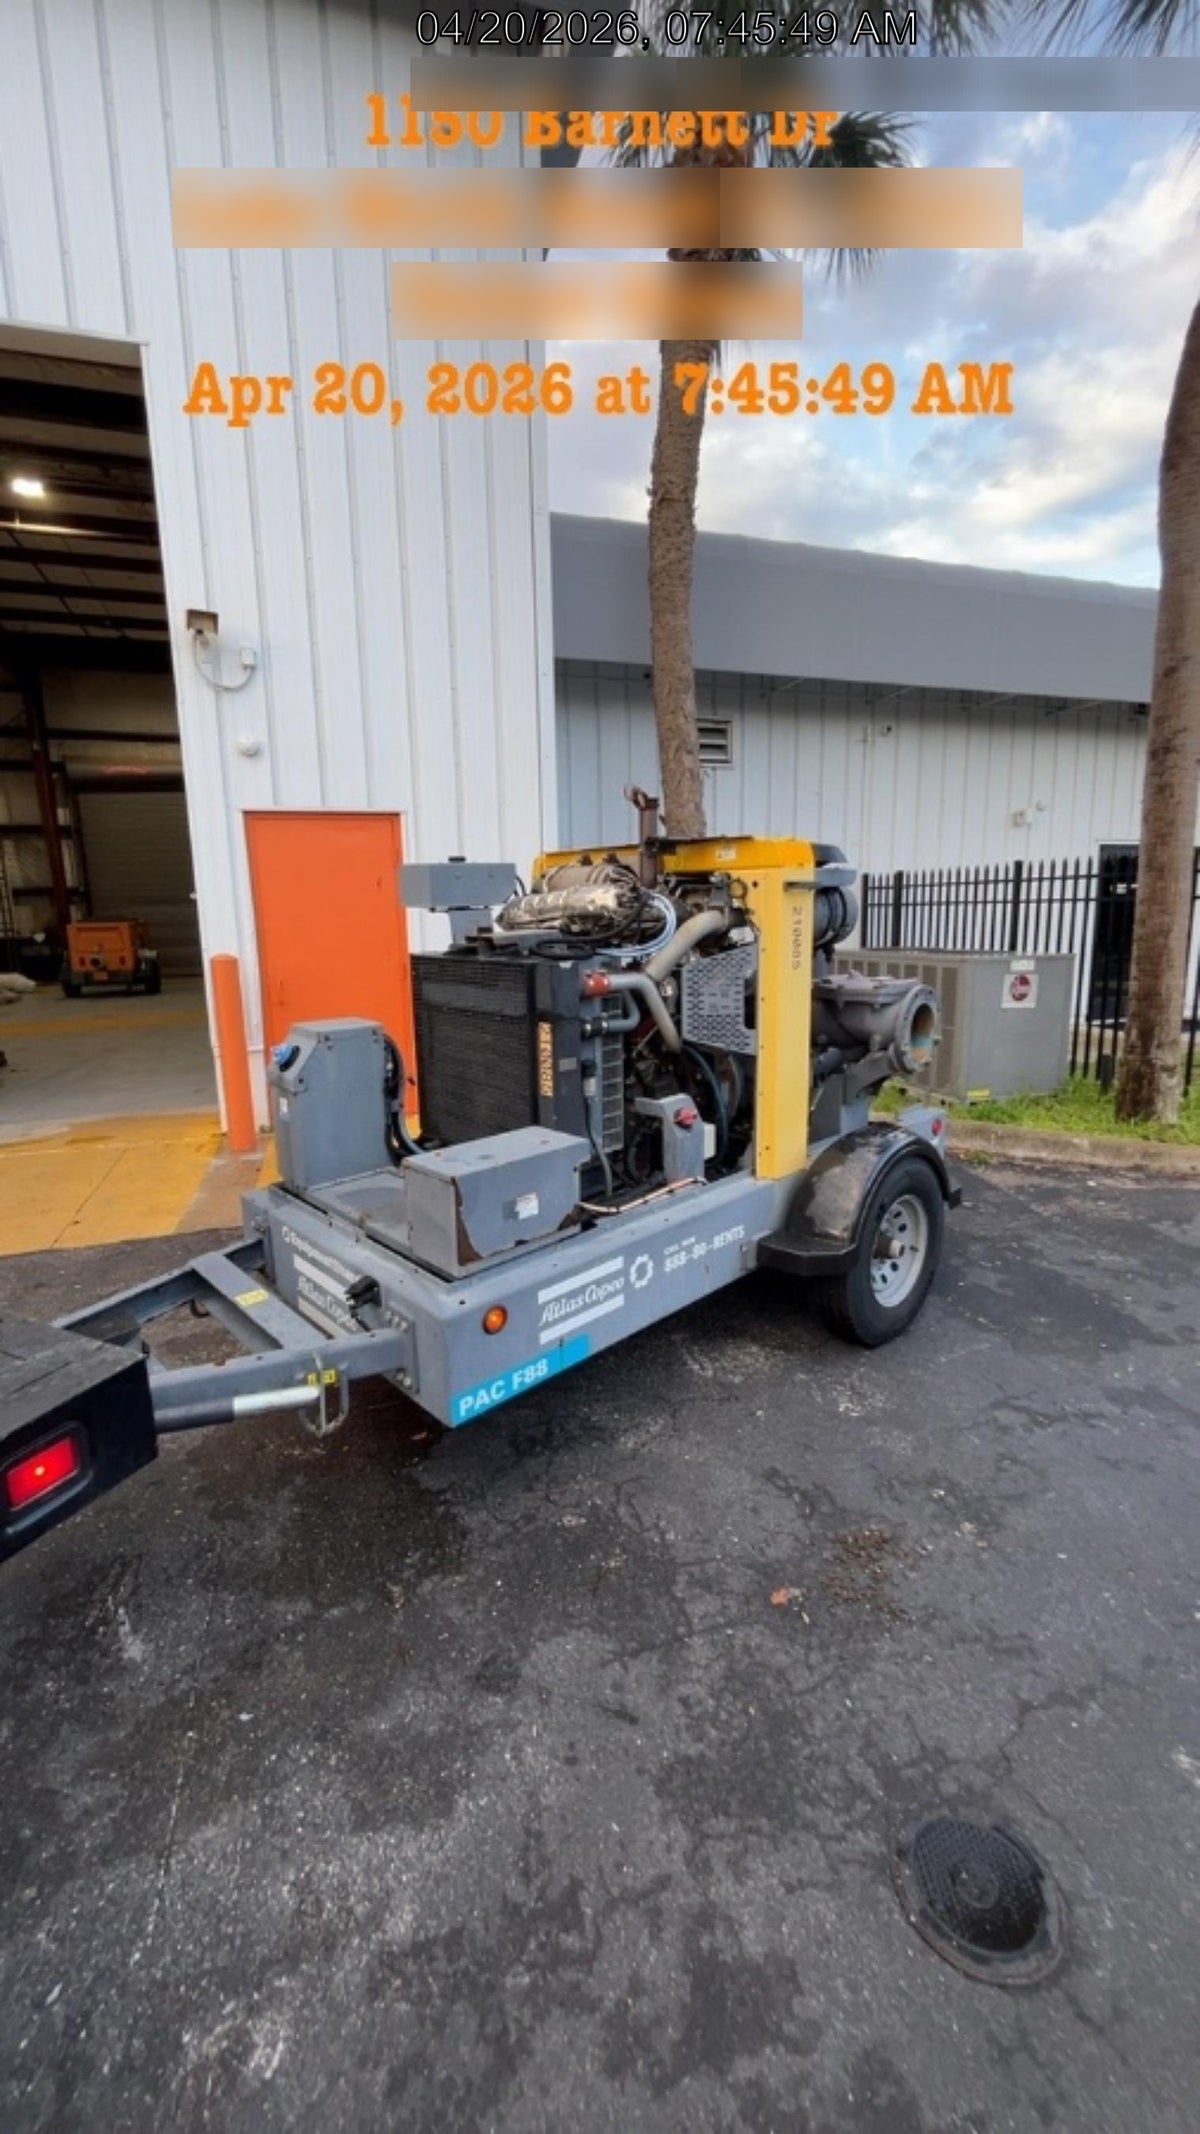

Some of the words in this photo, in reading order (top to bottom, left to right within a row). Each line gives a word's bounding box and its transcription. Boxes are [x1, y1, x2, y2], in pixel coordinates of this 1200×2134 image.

[538, 1294, 585, 1327] Atlas
[585, 1276, 625, 1304] Copco
[459, 1379, 506, 1417] PAC
[512, 1358, 549, 1391] F88
